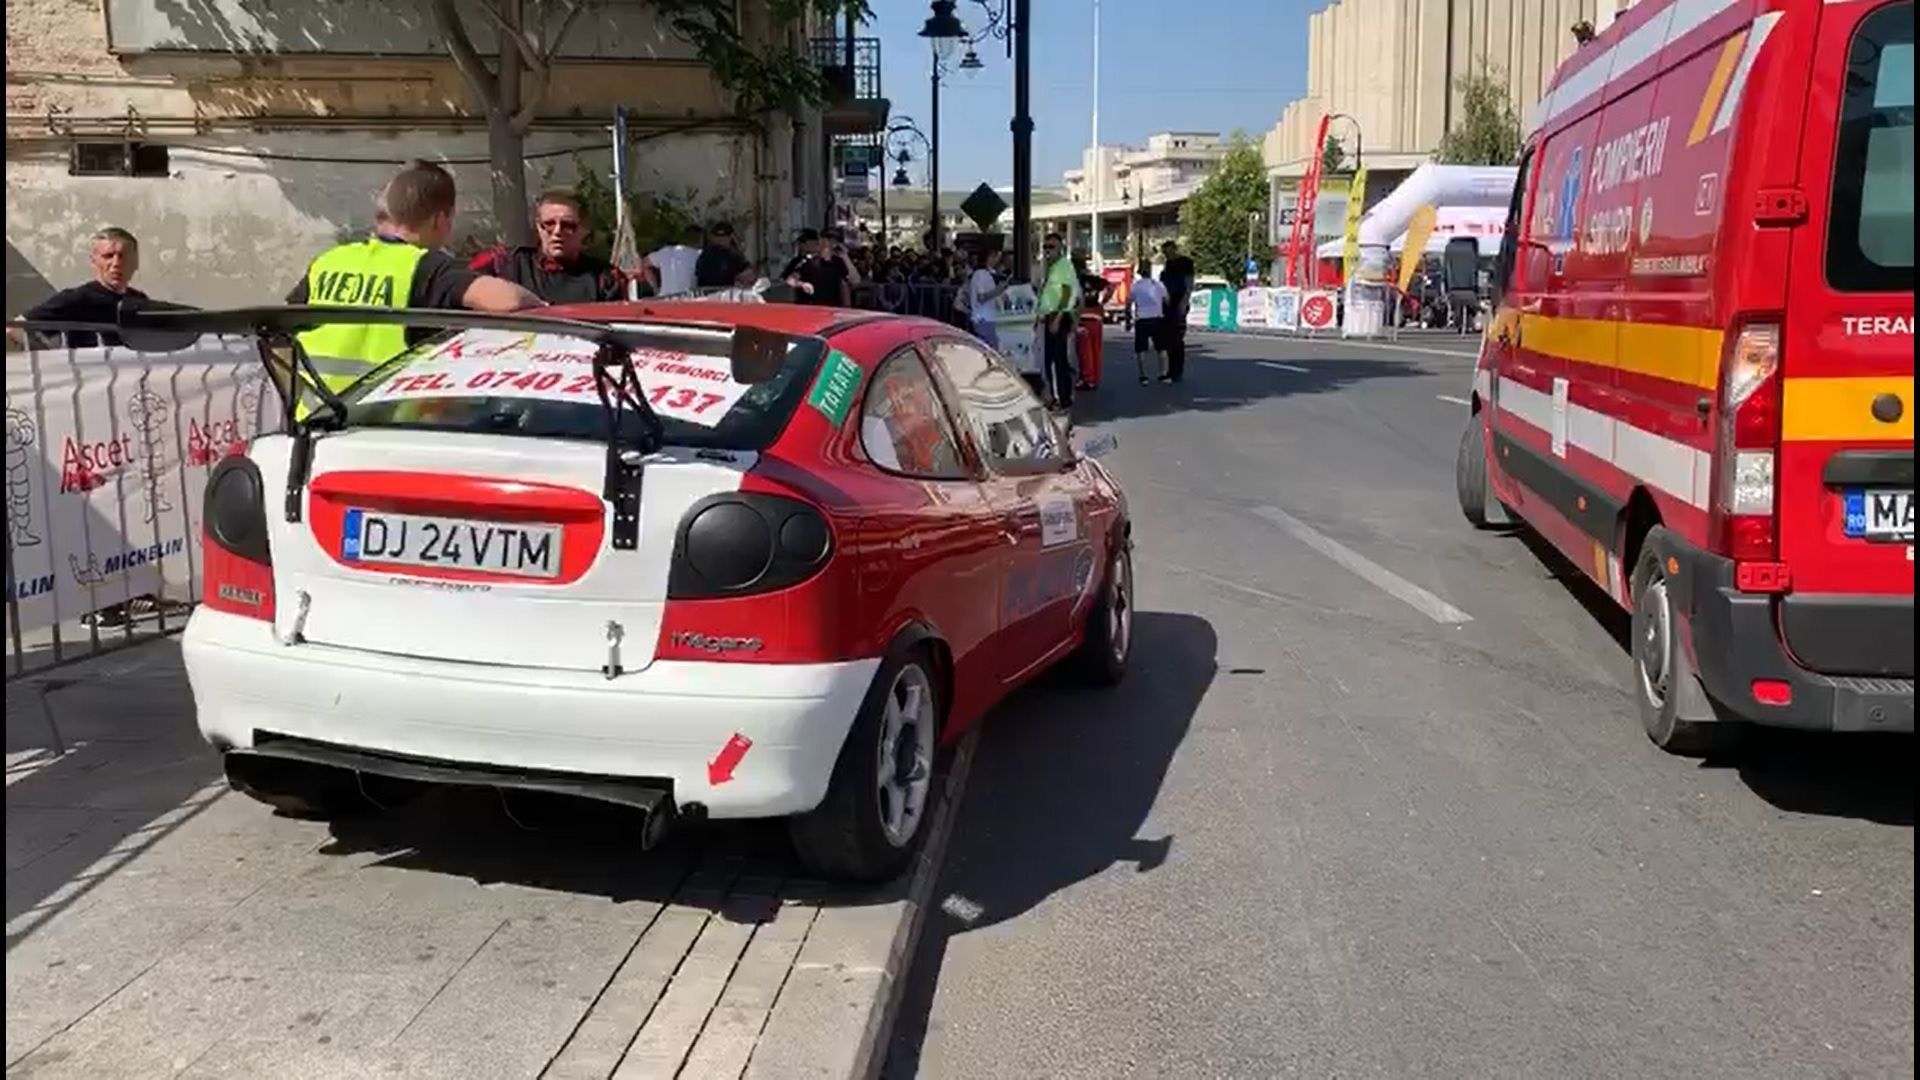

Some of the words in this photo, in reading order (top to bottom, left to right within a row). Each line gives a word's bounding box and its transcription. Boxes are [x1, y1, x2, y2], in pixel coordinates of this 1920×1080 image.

[310, 270, 393, 307] MEDIA
[386, 374, 456, 394] TEL.
[466, 369, 564, 391] 0740
[650, 385, 725, 414] 137
[654, 362, 731, 384] REMORCI
[820, 356, 859, 415] TAKATA
[62, 432, 135, 474] Ascet
[104, 537, 183, 575] MICHELIN
[363, 518, 407, 558] DJ
